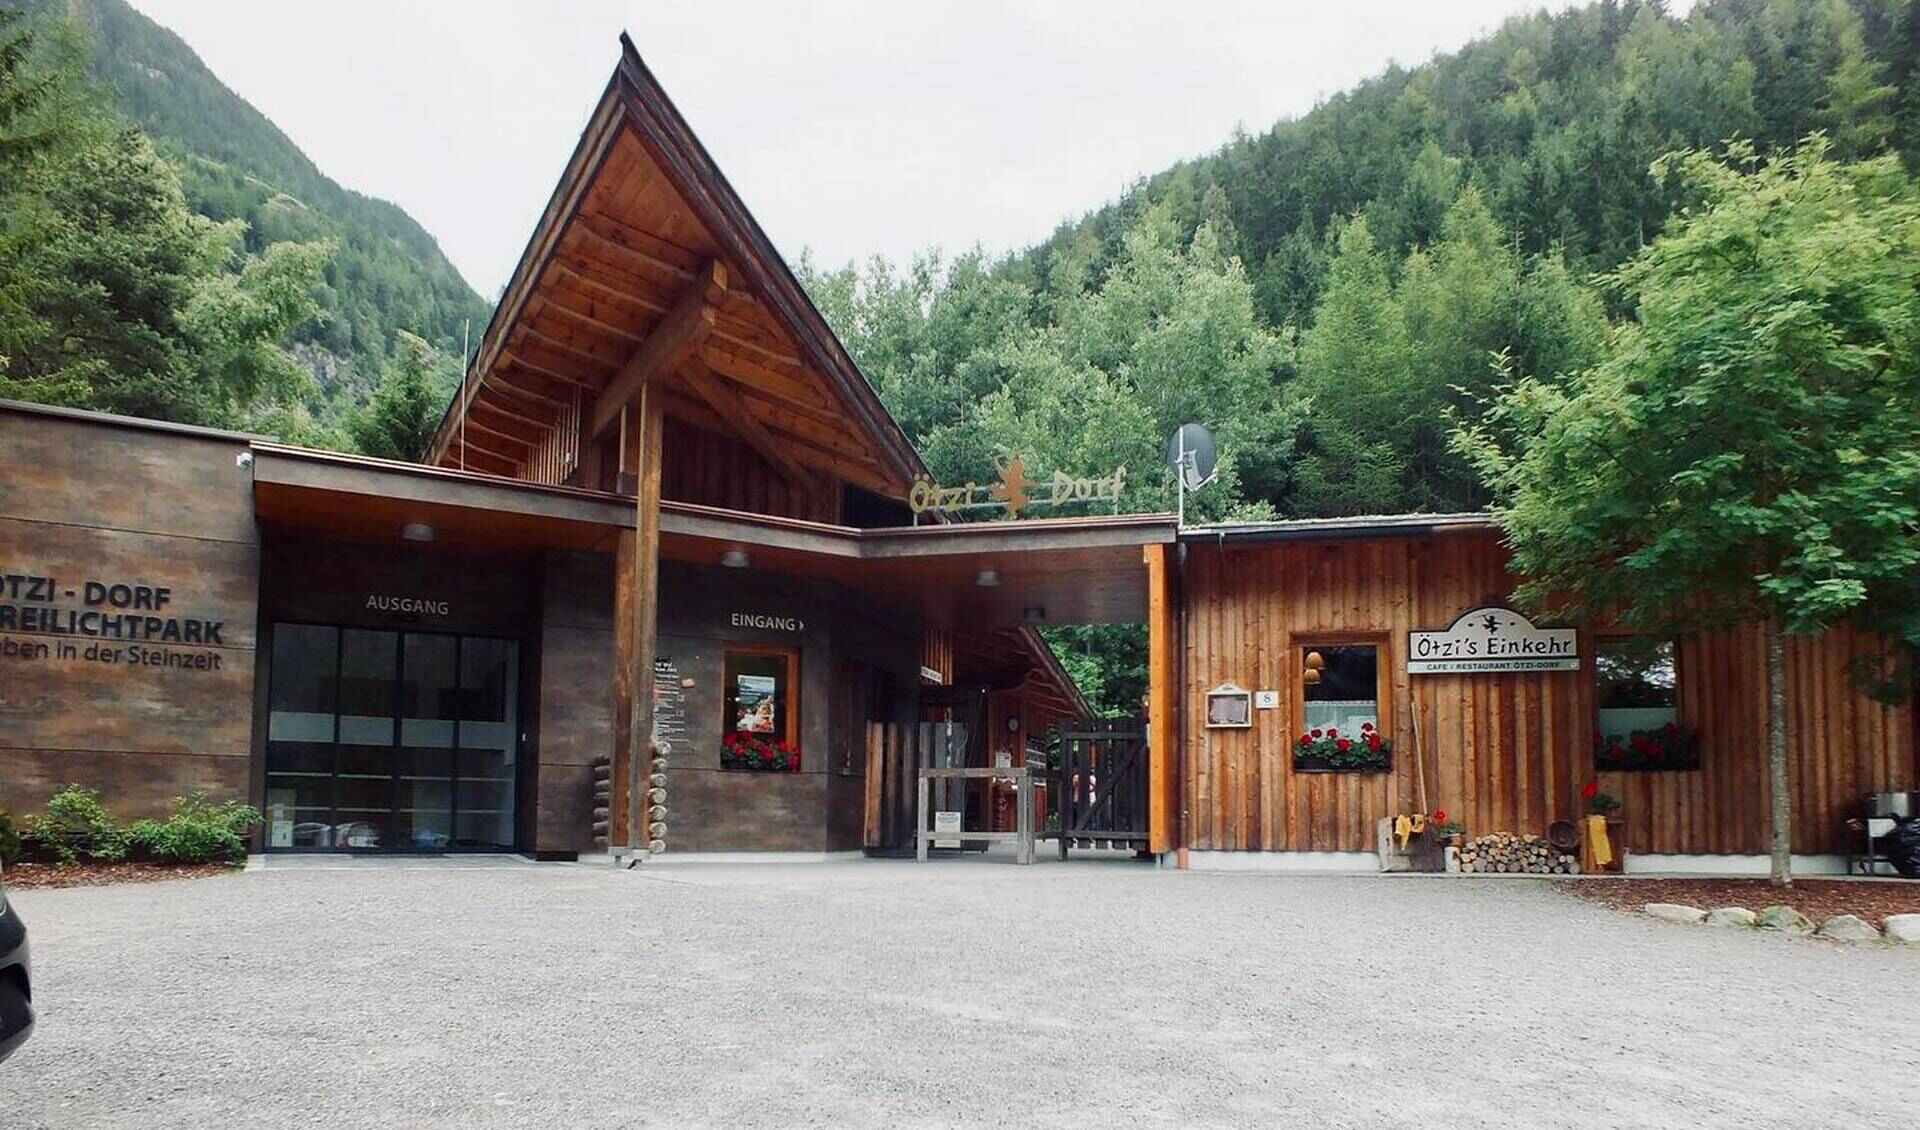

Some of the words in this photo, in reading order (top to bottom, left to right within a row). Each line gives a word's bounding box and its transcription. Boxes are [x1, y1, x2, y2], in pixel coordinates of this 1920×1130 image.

[909, 473, 976, 513] Ötzi
[1052, 465, 1127, 506] Dorf
[0, 574, 55, 602] TZI
[84, 581, 171, 611] DORF
[366, 594, 449, 615] AUSGANG
[731, 612, 796, 631] EINGANG
[57, 640, 76, 660] in
[84, 642, 121, 664] der
[127, 646, 222, 670] Steinzeit
[1487, 637, 1571, 655] Einkehr
[1456, 661, 1510, 670] RESTAURANT
